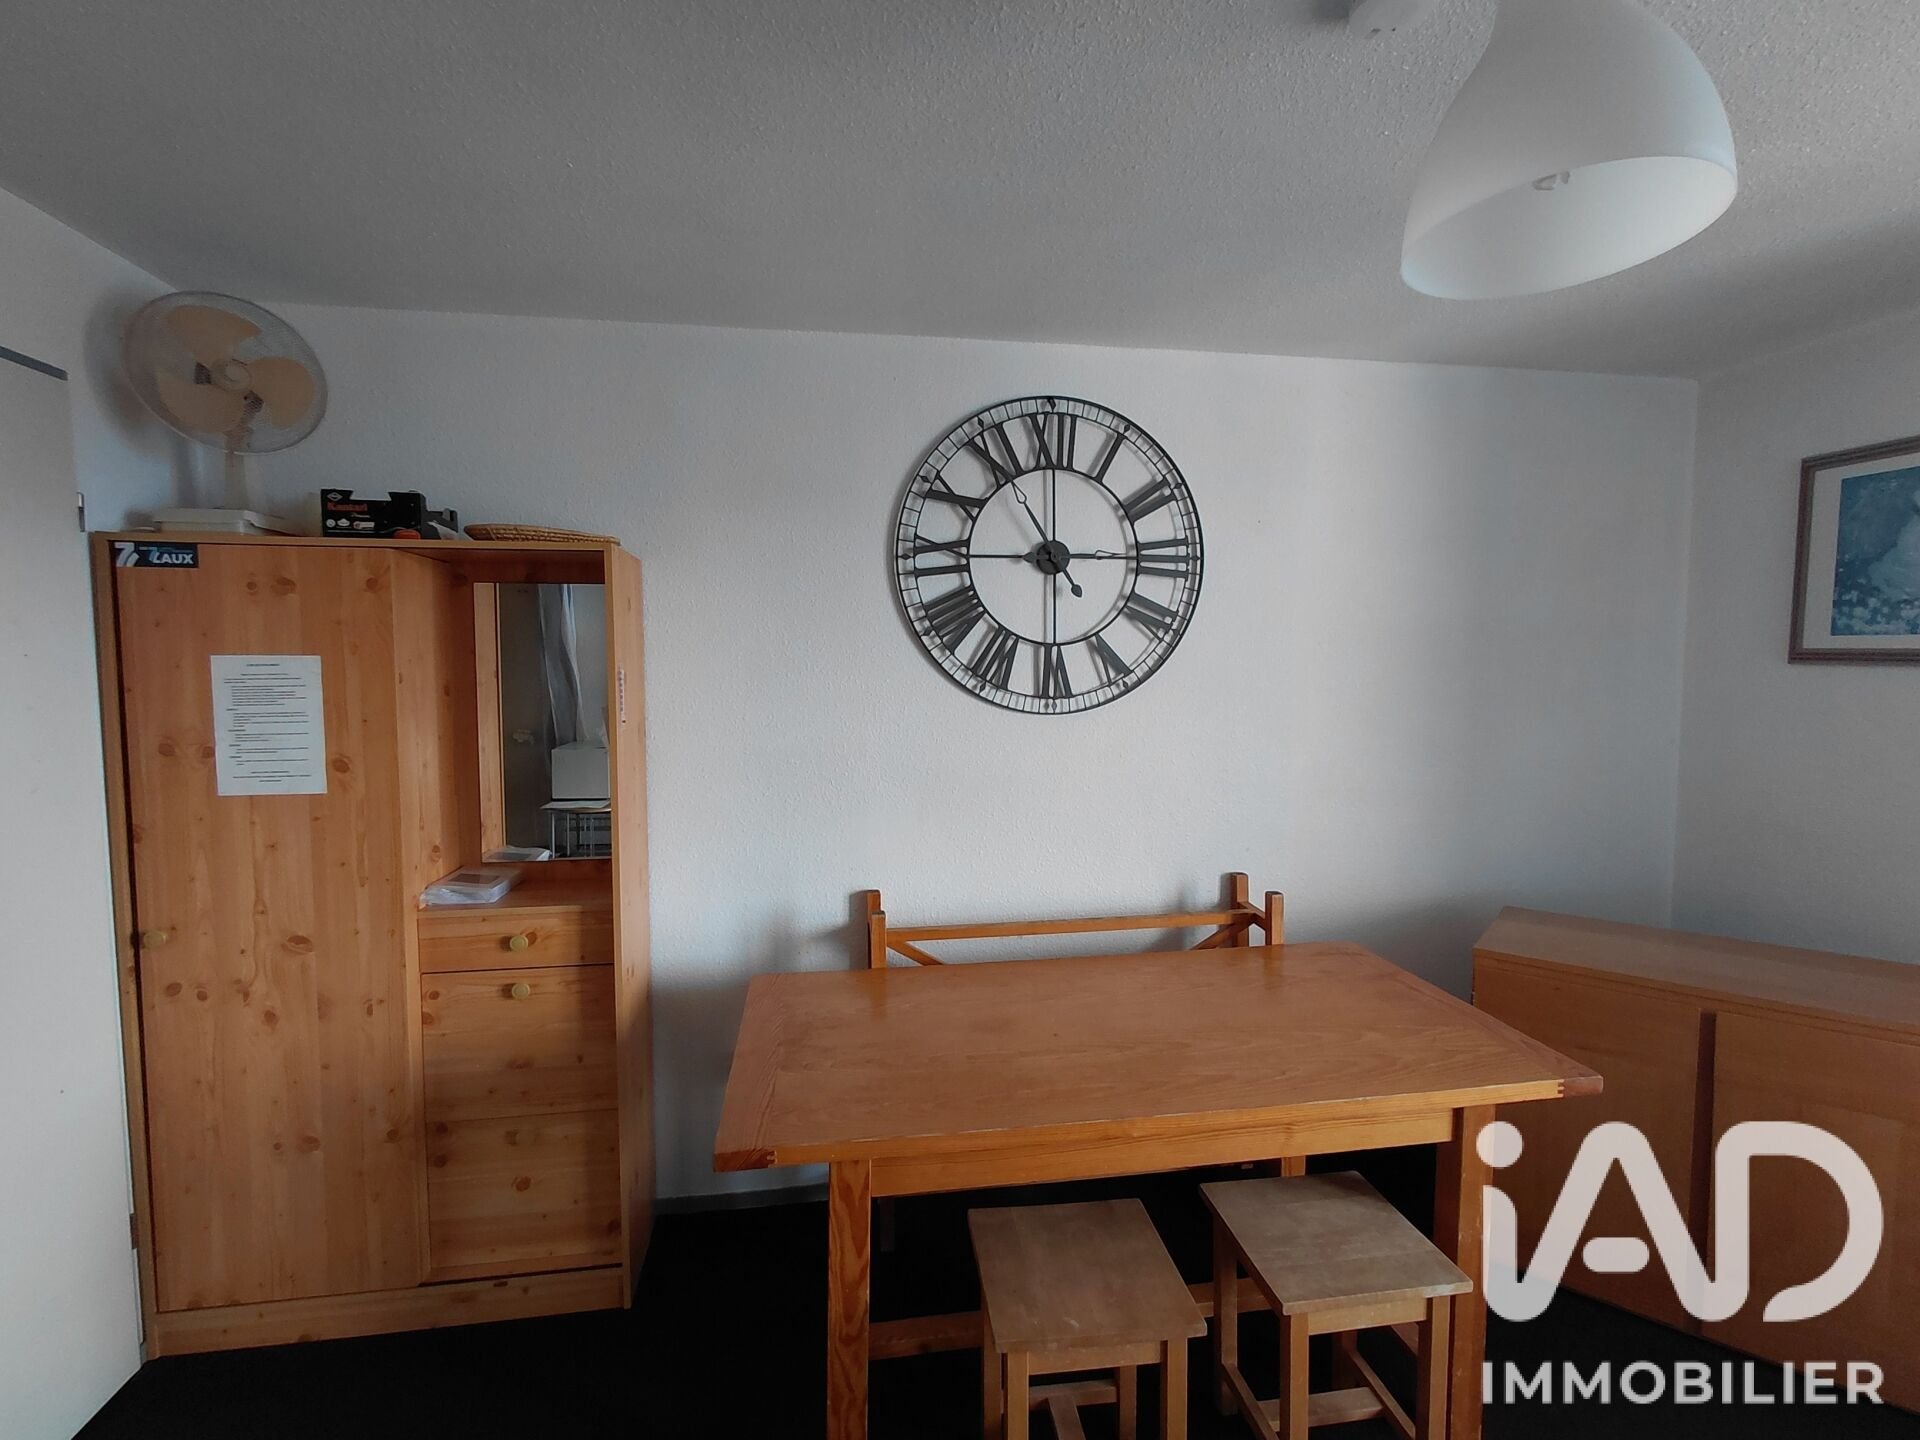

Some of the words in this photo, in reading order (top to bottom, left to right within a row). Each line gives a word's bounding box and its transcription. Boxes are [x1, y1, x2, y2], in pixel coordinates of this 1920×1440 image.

[1027, 412, 1077, 470] XII
[1094, 431, 1126, 483] I
[925, 471, 989, 522] X
[1122, 475, 1179, 524] II
[1137, 537, 1190, 579] III
